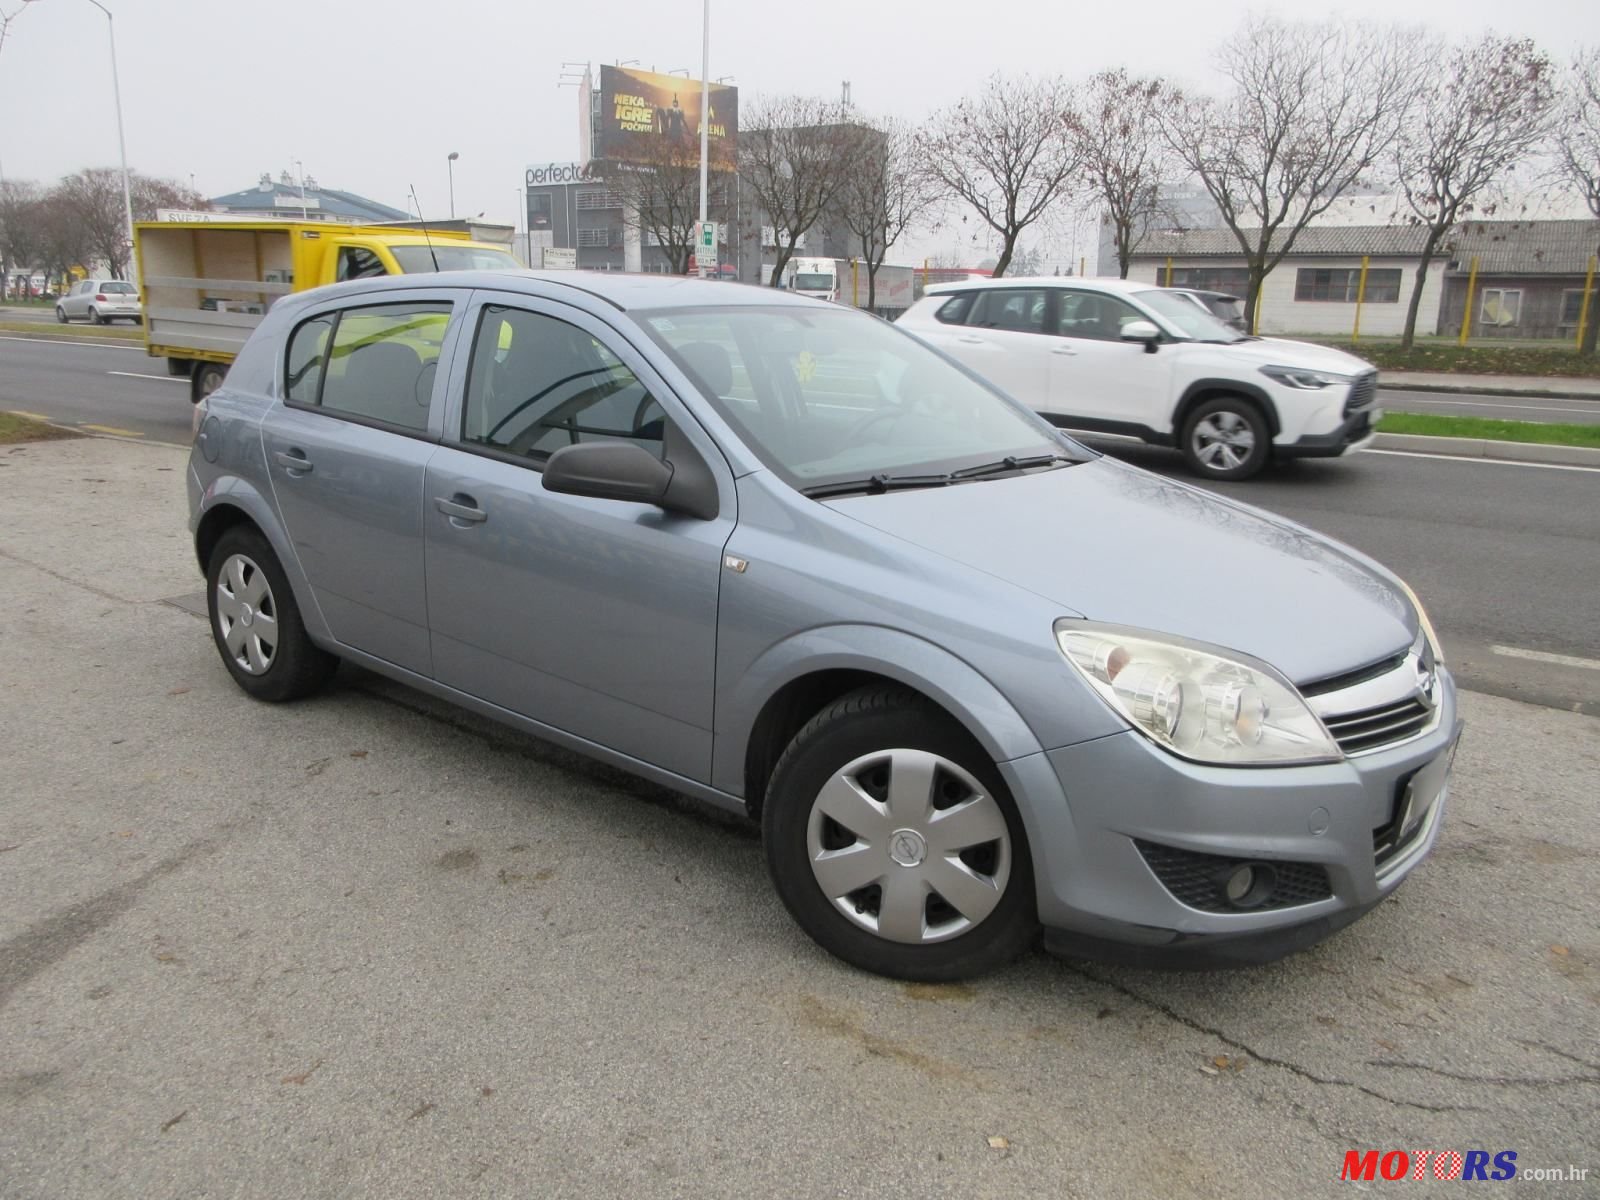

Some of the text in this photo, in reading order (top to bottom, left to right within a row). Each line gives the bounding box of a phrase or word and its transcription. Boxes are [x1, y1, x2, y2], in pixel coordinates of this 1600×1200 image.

[614, 94, 645, 108] NEKA
[615, 105, 653, 123] IGRE
[697, 122, 726, 137] AENA
